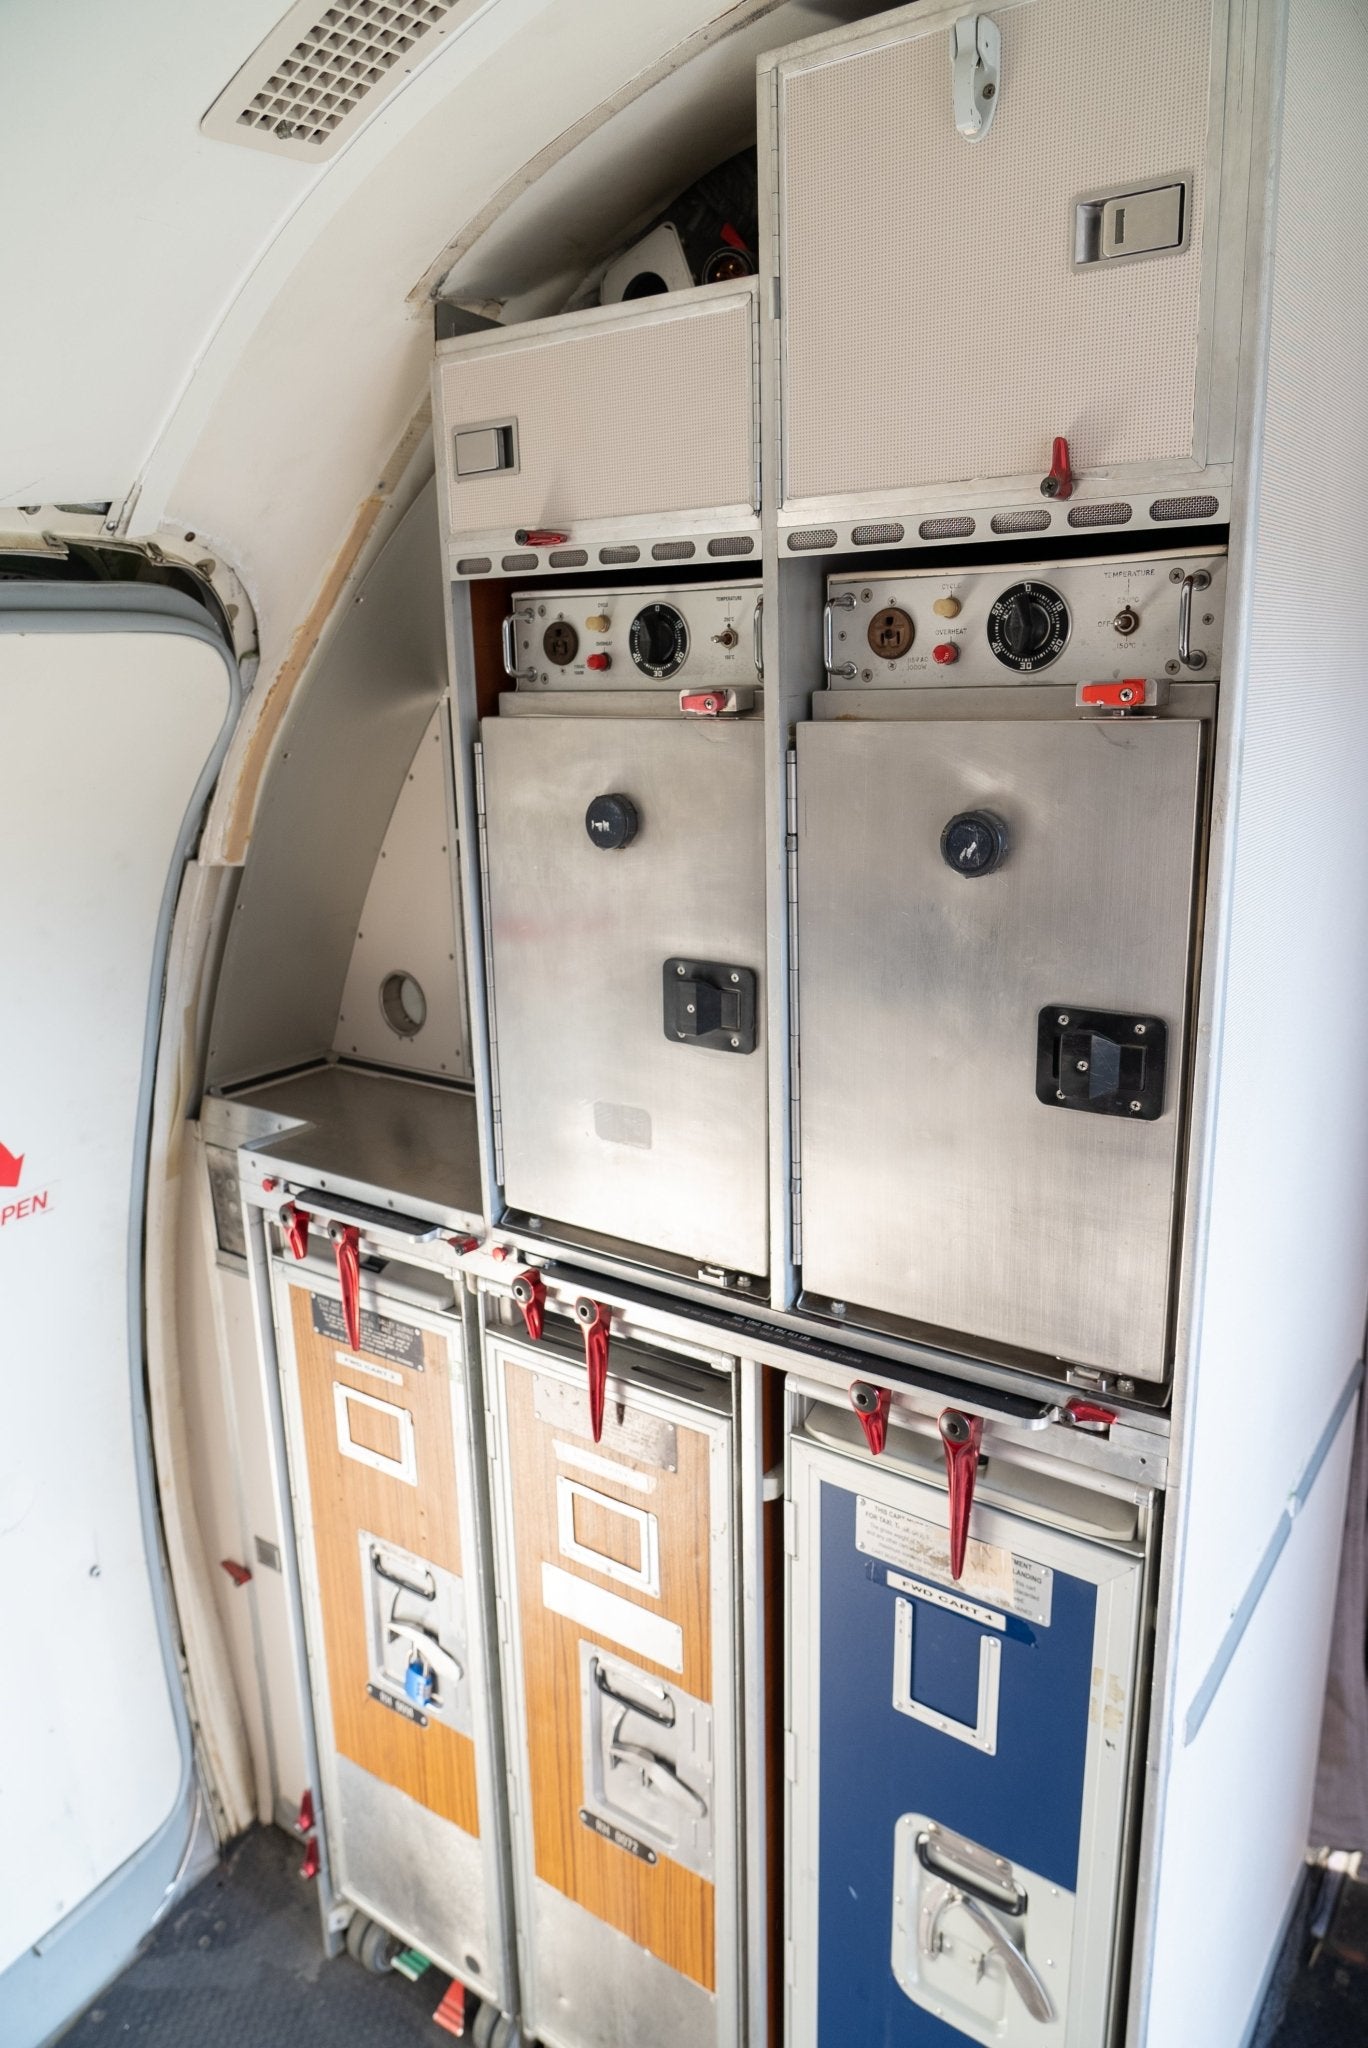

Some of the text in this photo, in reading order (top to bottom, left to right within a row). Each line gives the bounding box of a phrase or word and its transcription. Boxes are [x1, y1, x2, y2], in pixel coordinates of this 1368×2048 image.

[1104, 569, 1155, 578] TEMPERATURE
[1025, 584, 1031, 592] 0
[991, 602, 1002, 616] 50
[1054, 600, 1064, 611] 10
[675, 620, 684, 629] 10
[1097, 620, 1111, 628] OFF
[935, 627, 967, 636] OVERHEAT
[991, 641, 1002, 654] 40
[1052, 638, 1064, 652] 20
[633, 652, 640, 664] 40
[675, 651, 684, 663] 20
[1020, 662, 1032, 670] 30
[865, 1511, 877, 1519] FOR
[874, 1504, 887, 1515] THIS
[1012, 1568, 1042, 1585] LANDING
[902, 1580, 933, 1597] FWD
[939, 1595, 980, 1615] CART
